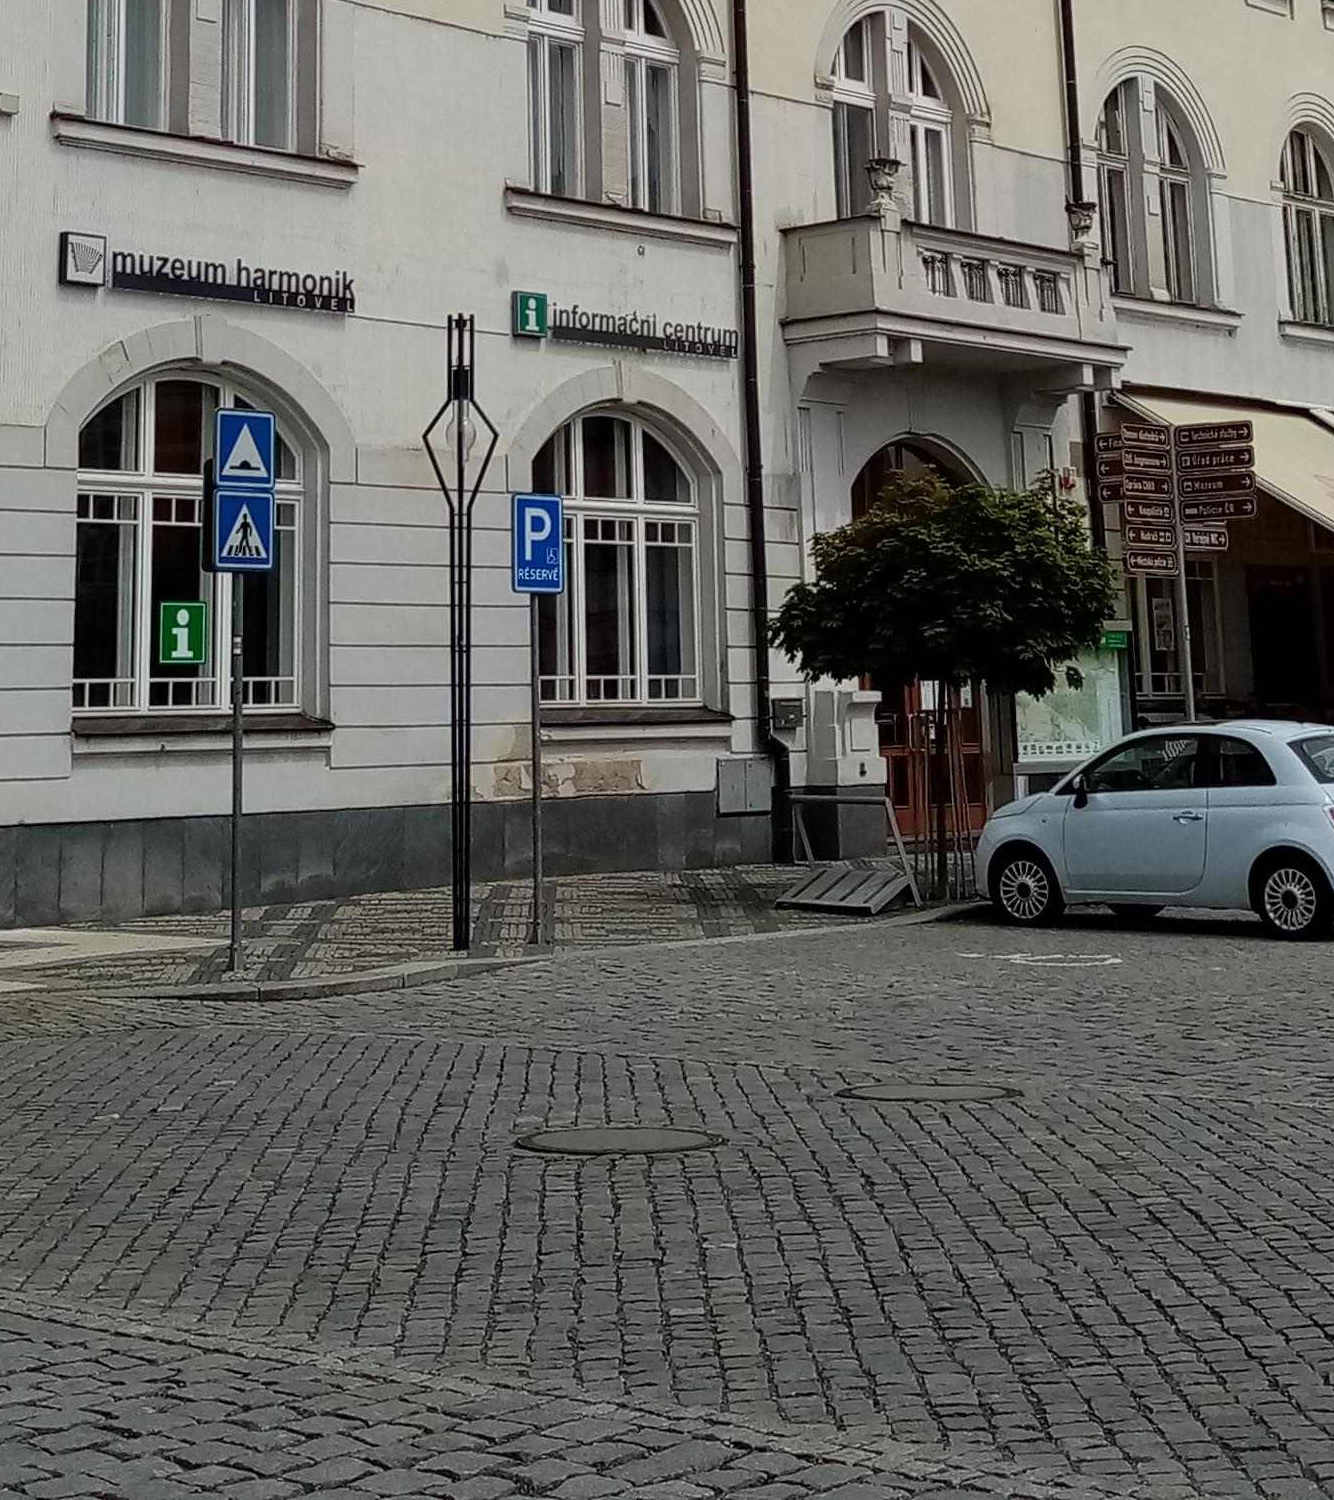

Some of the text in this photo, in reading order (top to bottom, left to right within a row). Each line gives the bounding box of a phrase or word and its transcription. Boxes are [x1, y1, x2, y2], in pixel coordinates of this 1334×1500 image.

[112, 250, 355, 298] muzeum harmonik
[253, 289, 354, 312] LITOVEL
[552, 302, 739, 347] informační centrum
[663, 339, 738, 358] LITOVEL
[1212, 452, 1235, 466] práce
[1198, 501, 1235, 516] Policie ČR
[523, 506, 552, 562] P
[518, 565, 560, 582] RÉSERVÉ
